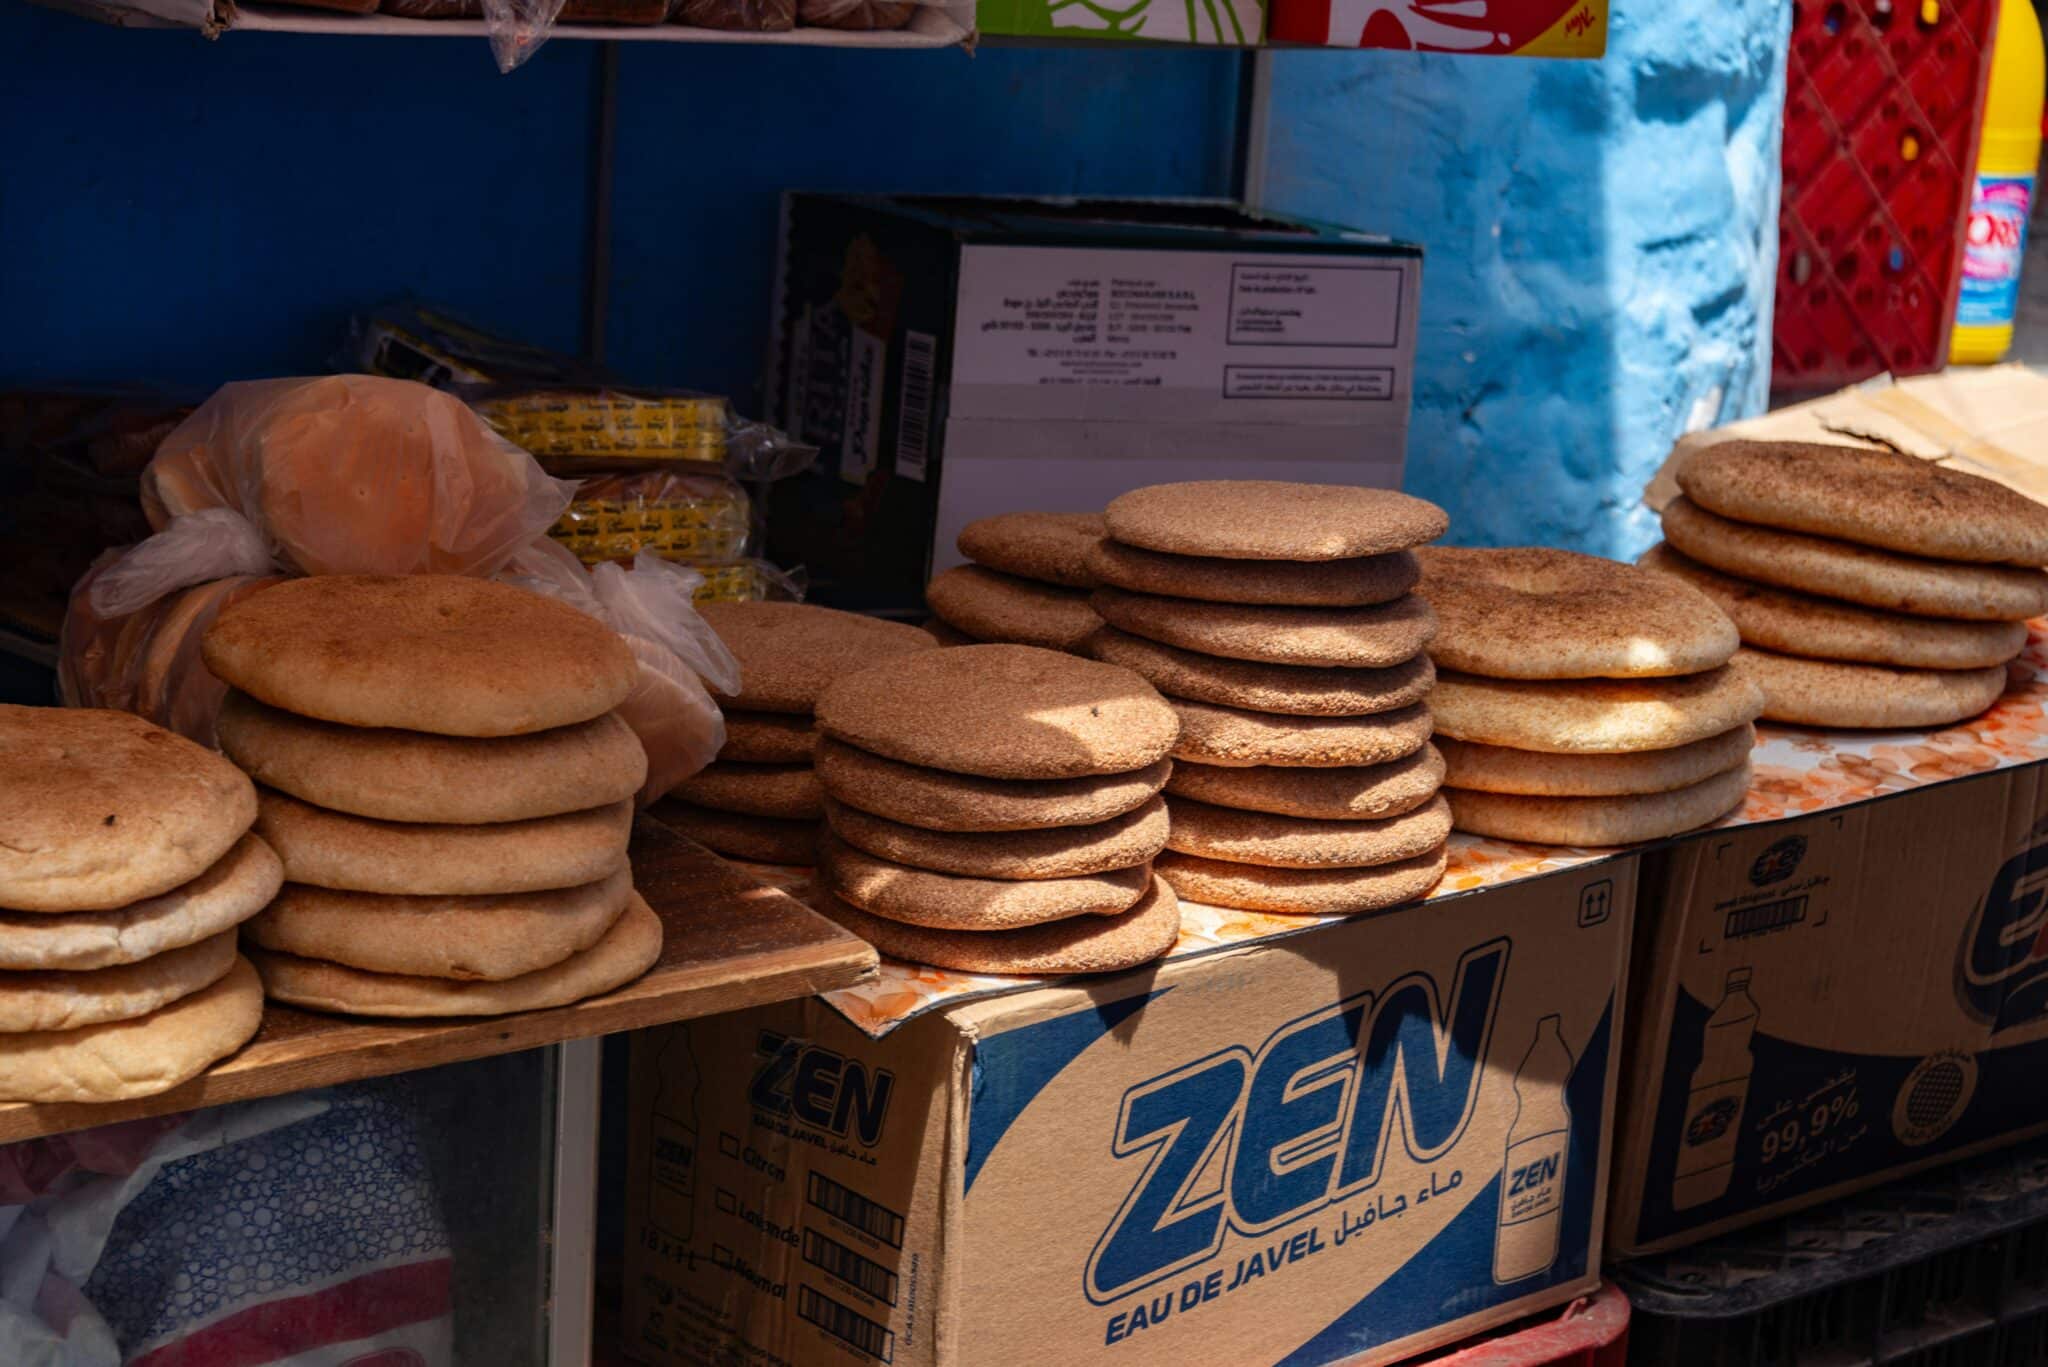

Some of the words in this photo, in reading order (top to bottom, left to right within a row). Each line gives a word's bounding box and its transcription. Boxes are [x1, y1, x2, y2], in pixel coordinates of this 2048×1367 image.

[750, 1028, 896, 1149] ZEN
[791, 1128, 828, 1149] JAVEL
[1085, 937, 1511, 1304] ZEN
[1761, 1087, 1858, 1164] 99,9%
[742, 1141, 786, 1185] Citron
[1415, 1168, 1464, 1207] ماء
[1508, 1151, 1561, 1197] ZEN
[1333, 1192, 1409, 1247] جافيل
[1105, 1291, 1173, 1347] EAU
[1178, 1268, 1223, 1314] DE
[1226, 1226, 1326, 1293] JAVEL
